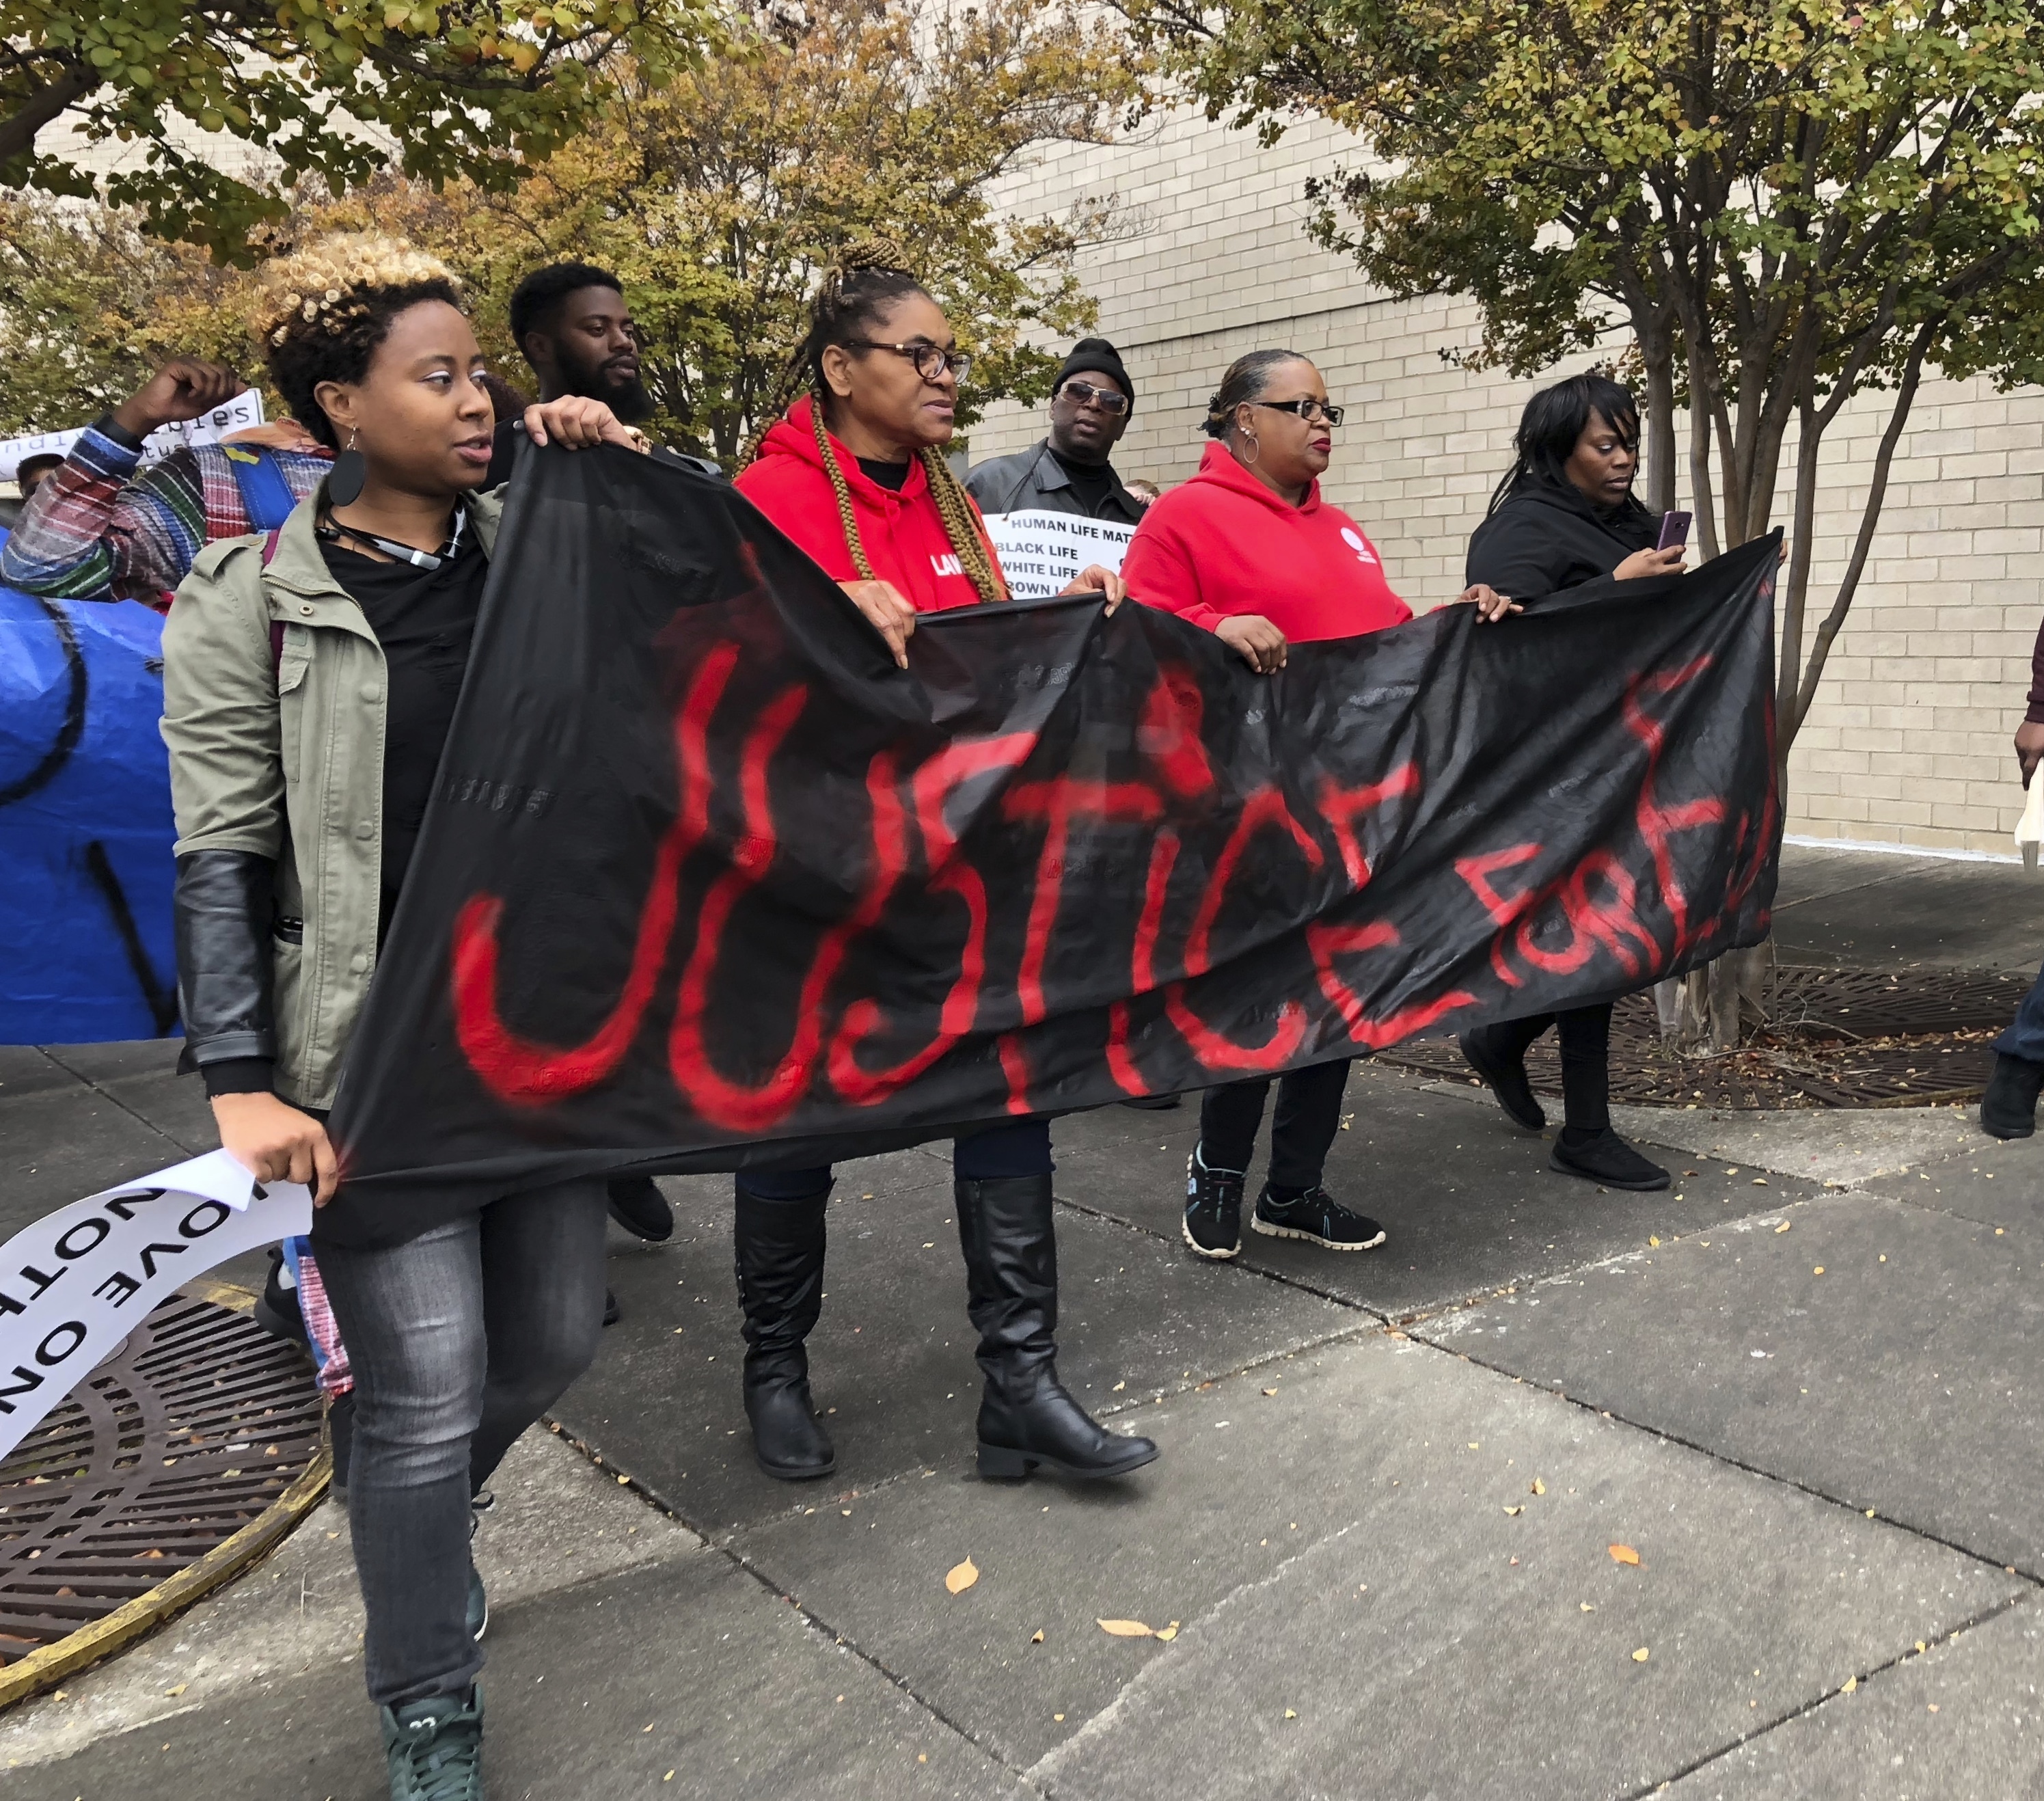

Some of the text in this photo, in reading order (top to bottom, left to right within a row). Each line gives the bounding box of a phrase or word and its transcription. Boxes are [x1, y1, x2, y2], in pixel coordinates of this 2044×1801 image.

[1011, 518, 1133, 544] HUMAN LIFE MAT
[995, 542, 1078, 560] BLACK LIFE
[999, 561, 1078, 580] WHITE LIFE
[448, 639, 1482, 1133] JUSTICE
[1454, 841, 1663, 991] FOR
[92, 1182, 269, 1309] OVE
